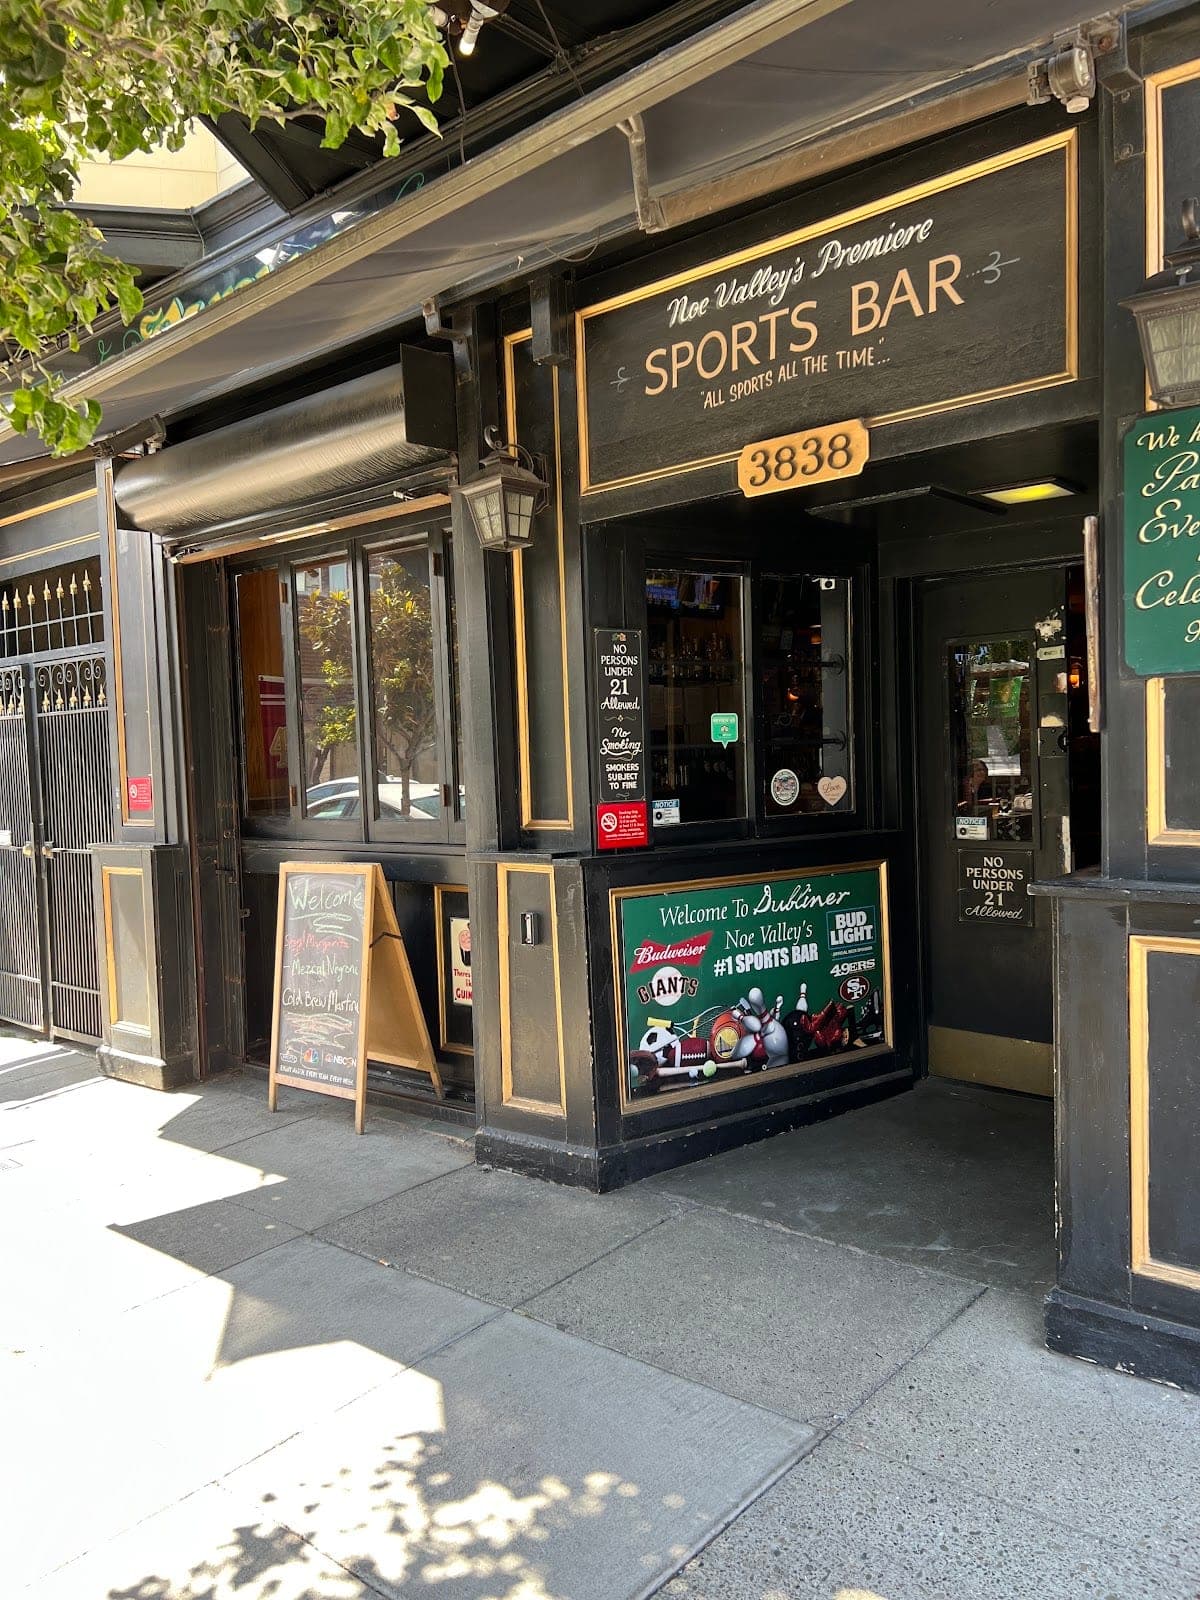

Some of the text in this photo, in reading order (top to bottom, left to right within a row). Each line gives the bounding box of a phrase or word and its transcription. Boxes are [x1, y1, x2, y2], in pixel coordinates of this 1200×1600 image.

[667, 218, 934, 328] Noe Valley's Premiere
[644, 254, 965, 396] SPORTS BAR
[729, 370, 773, 402] SPORTS
[778, 361, 798, 383] ALL
[802, 354, 828, 375] THE
[1136, 425, 1180, 451] We
[749, 433, 854, 487] 3838
[613, 644, 627, 654] NO
[600, 655, 638, 666] PERSONS
[604, 667, 634, 677] UNDER
[610, 678, 630, 696] 21
[611, 727, 632, 737] No
[600, 738, 643, 756] Smoking
[605, 763, 639, 772] SMOKERS
[607, 773, 638, 781] SUBJECT
[609, 781, 637, 790] TO FINE
[983, 856, 1004, 868] NO
[966, 867, 1024, 880] PERSONS
[288, 879, 363, 911] Welcome
[972, 880, 1015, 892] UNDER
[659, 883, 851, 928] Welcome To Dubliner
[984, 892, 1003, 906] 21
[835, 910, 867, 930] BUD
[965, 905, 1023, 919] Allowed
[724, 920, 813, 950] Noe Valley's
[830, 925, 874, 946] LIGHT
[633, 943, 706, 965] Budweiser
[713, 943, 819, 977] #1 SPORTS BAR
[830, 958, 876, 978] 49ERS
[282, 987, 303, 1006] Cold
[305, 991, 327, 1010] Brew
[637, 976, 699, 1004] GIANTS
